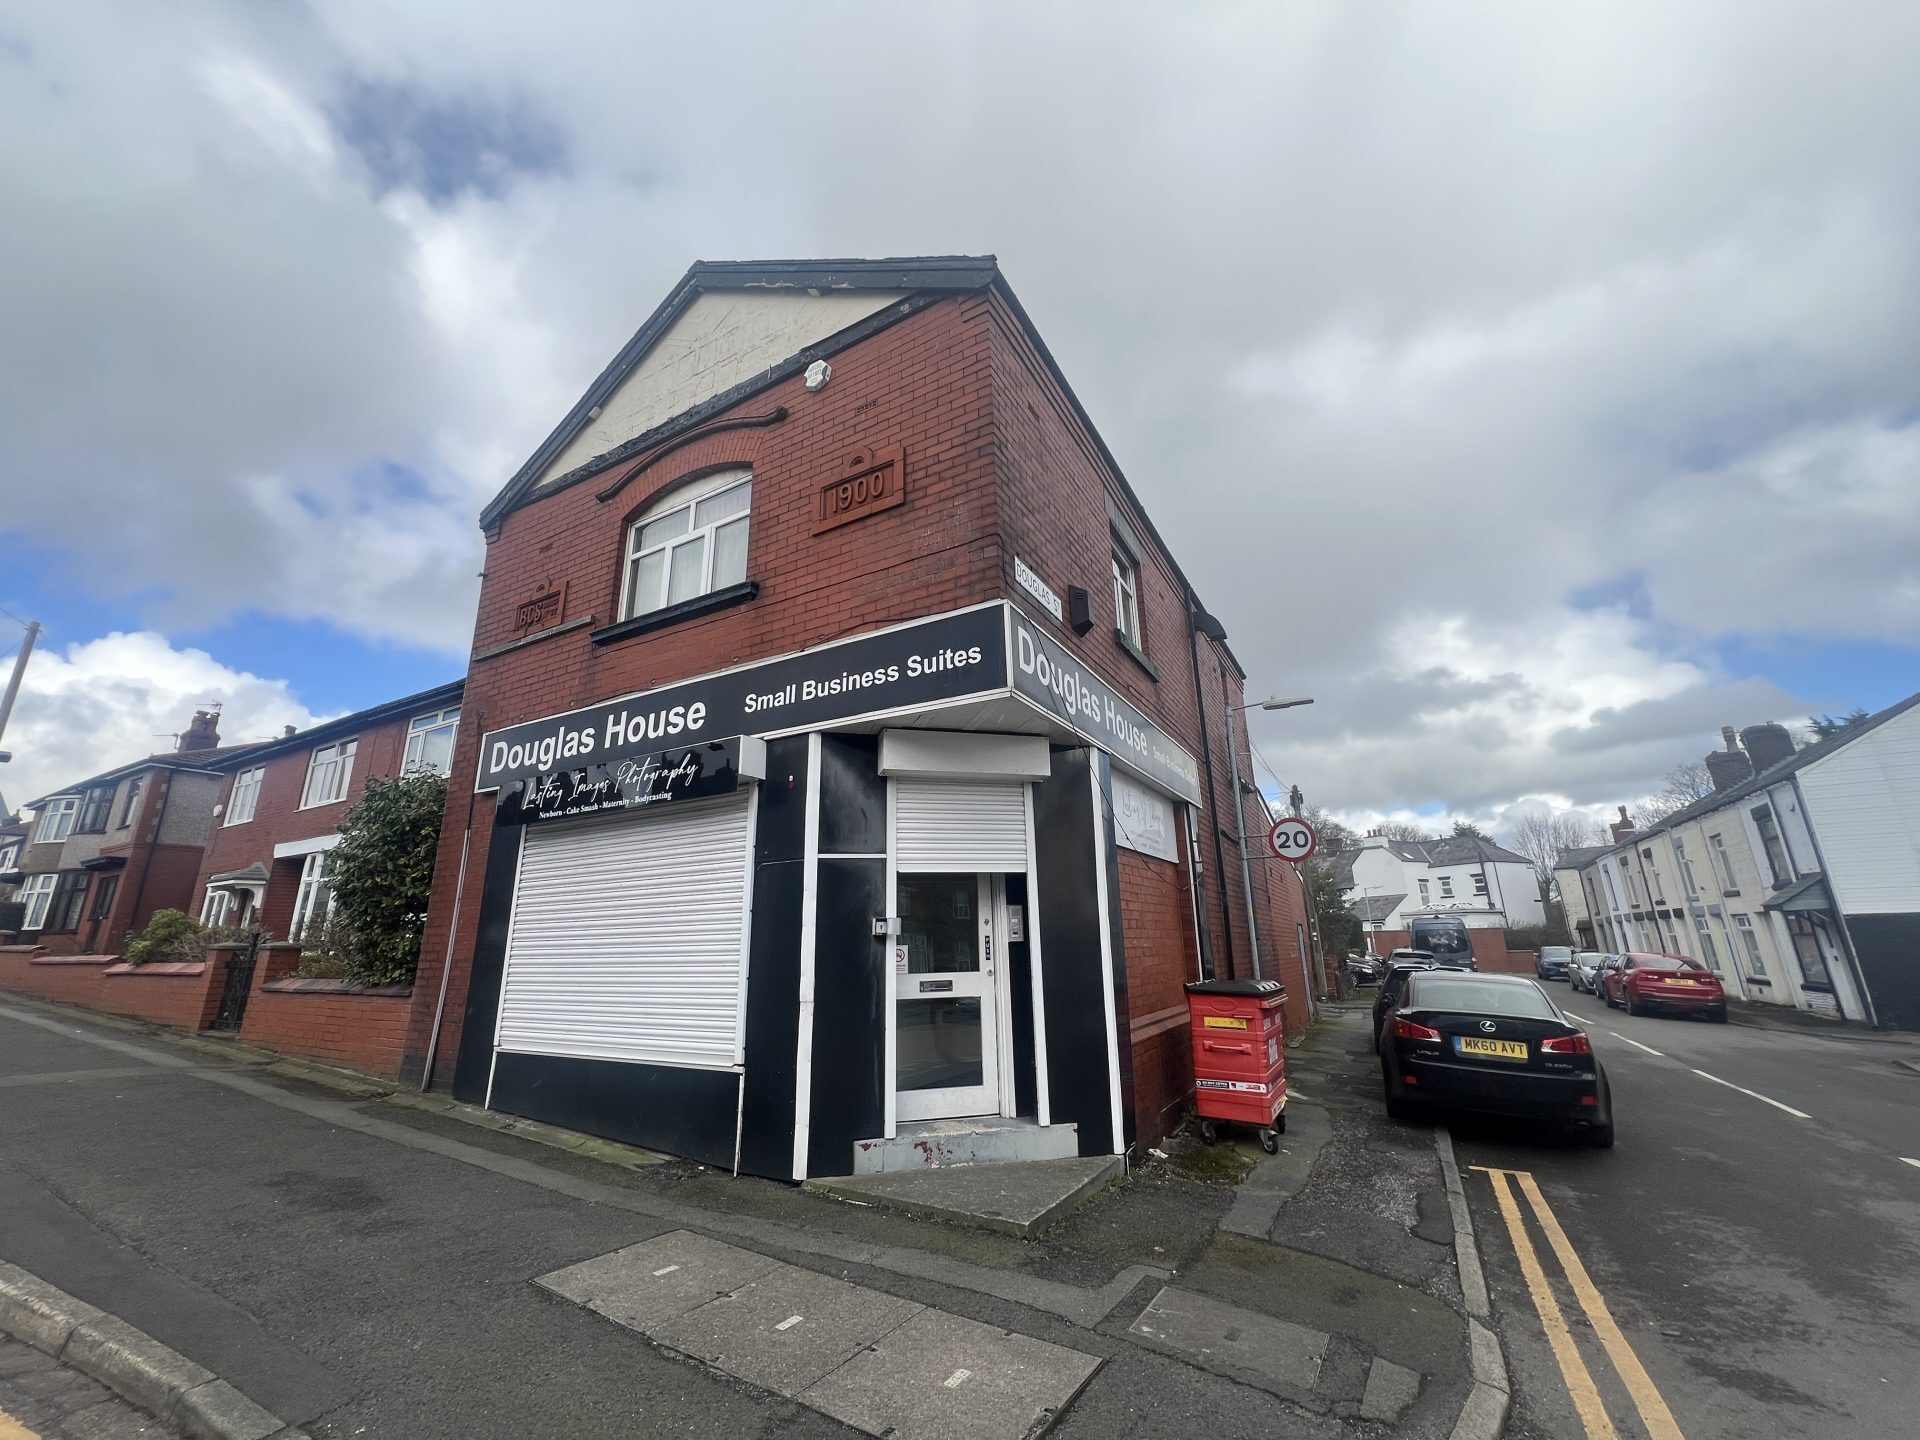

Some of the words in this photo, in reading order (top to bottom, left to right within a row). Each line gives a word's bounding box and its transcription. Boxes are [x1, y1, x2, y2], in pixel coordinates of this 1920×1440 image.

[832, 472, 883, 513] 1900
[1017, 563, 1050, 605] DOUGLAS
[744, 684, 796, 713] Small
[802, 665, 900, 701] Business
[906, 646, 982, 678] Suites
[1018, 625, 1100, 722] Douglas
[1104, 695, 1147, 756] House
[490, 727, 595, 773] Douglas
[604, 701, 706, 748] House
[522, 776, 563, 810] Lasting
[568, 773, 612, 804] Images
[614, 753, 699, 793] Photography
[539, 809, 562, 819] Newborn
[566, 806, 580, 816] Cake
[580, 803, 598, 813] Smash
[602, 798, 630, 809] Maternity
[634, 791, 672, 804] Bodycasting
[1276, 830, 1309, 849] 20
[1464, 1038, 1496, 1052] MK60
[1501, 1042, 1524, 1055] AVT
